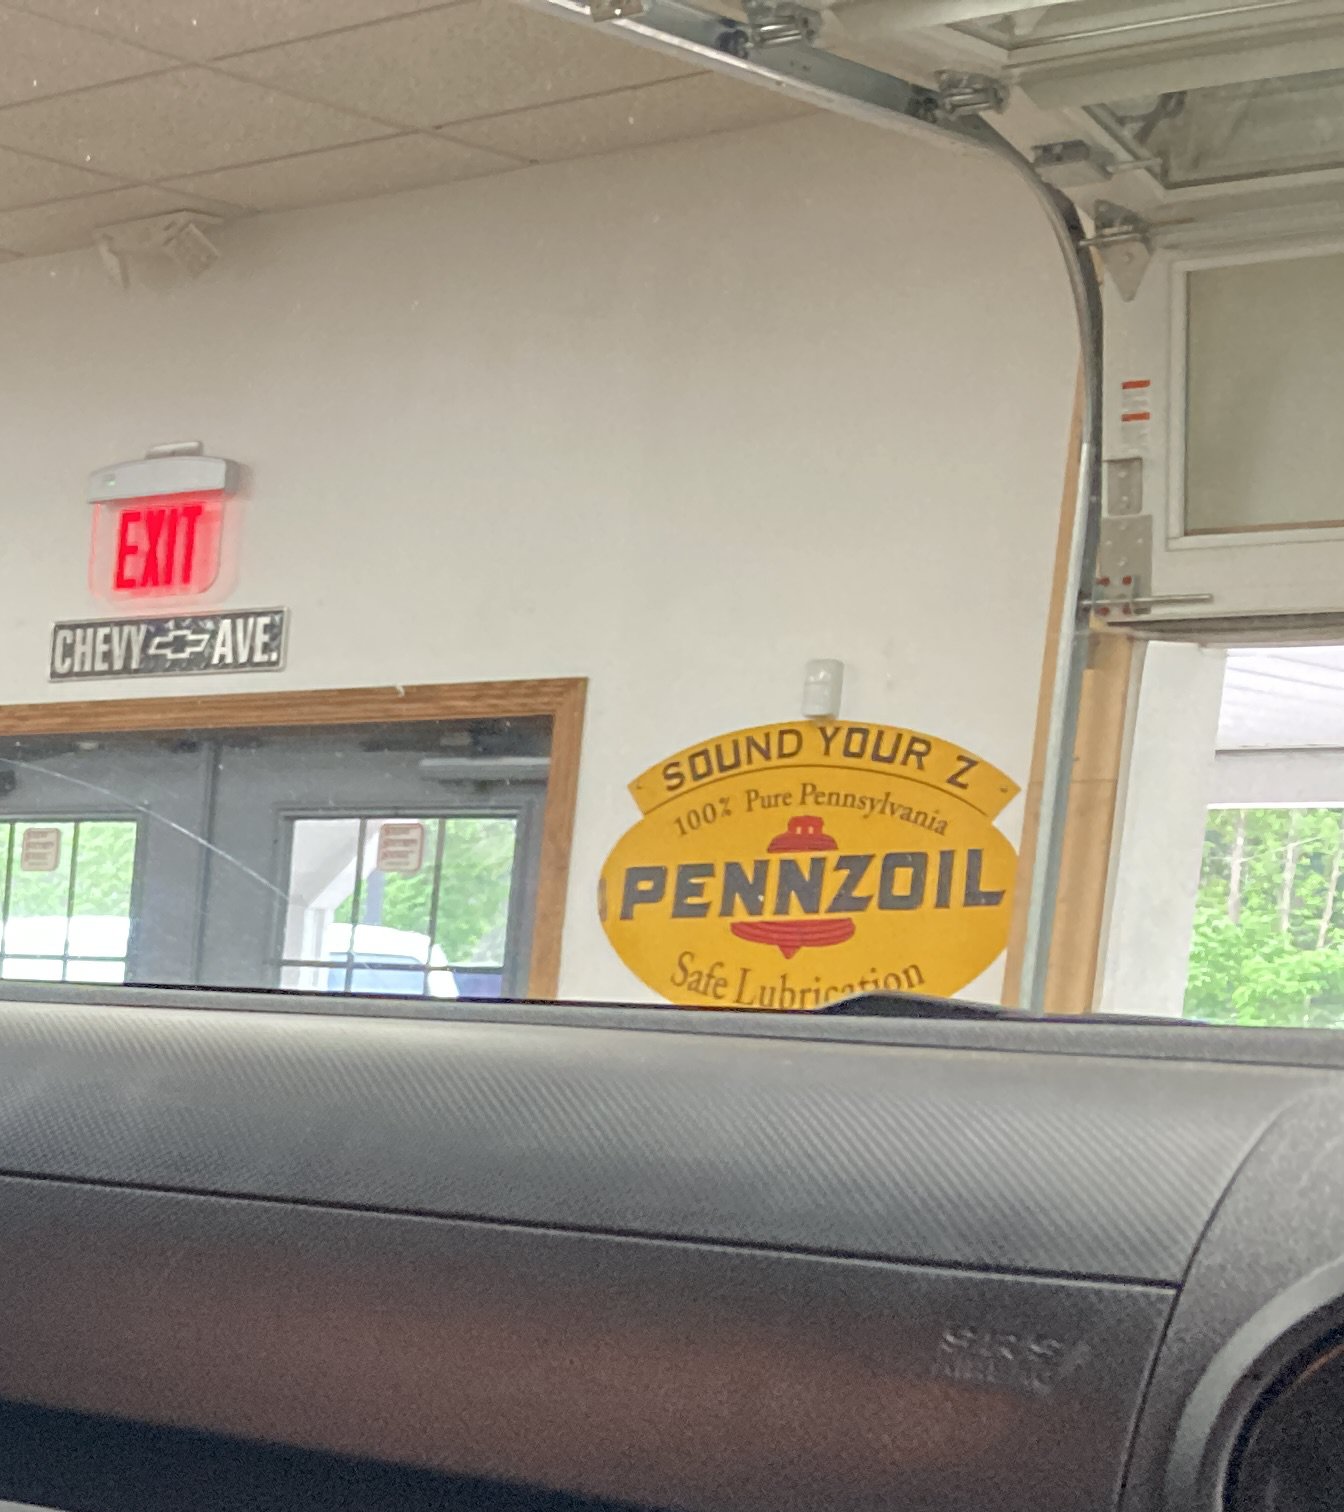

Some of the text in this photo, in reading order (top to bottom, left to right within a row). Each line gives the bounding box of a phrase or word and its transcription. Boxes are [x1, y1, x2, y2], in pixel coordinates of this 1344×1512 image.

[115, 505, 203, 588] EXIT
[53, 616, 277, 674] CHEVY AVE.
[662, 727, 980, 791] SOUND YOUR Z
[673, 782, 949, 838] 100% Pure Pennsylvania
[619, 848, 1007, 920] PENNZOIL
[670, 951, 728, 1000] Safe
